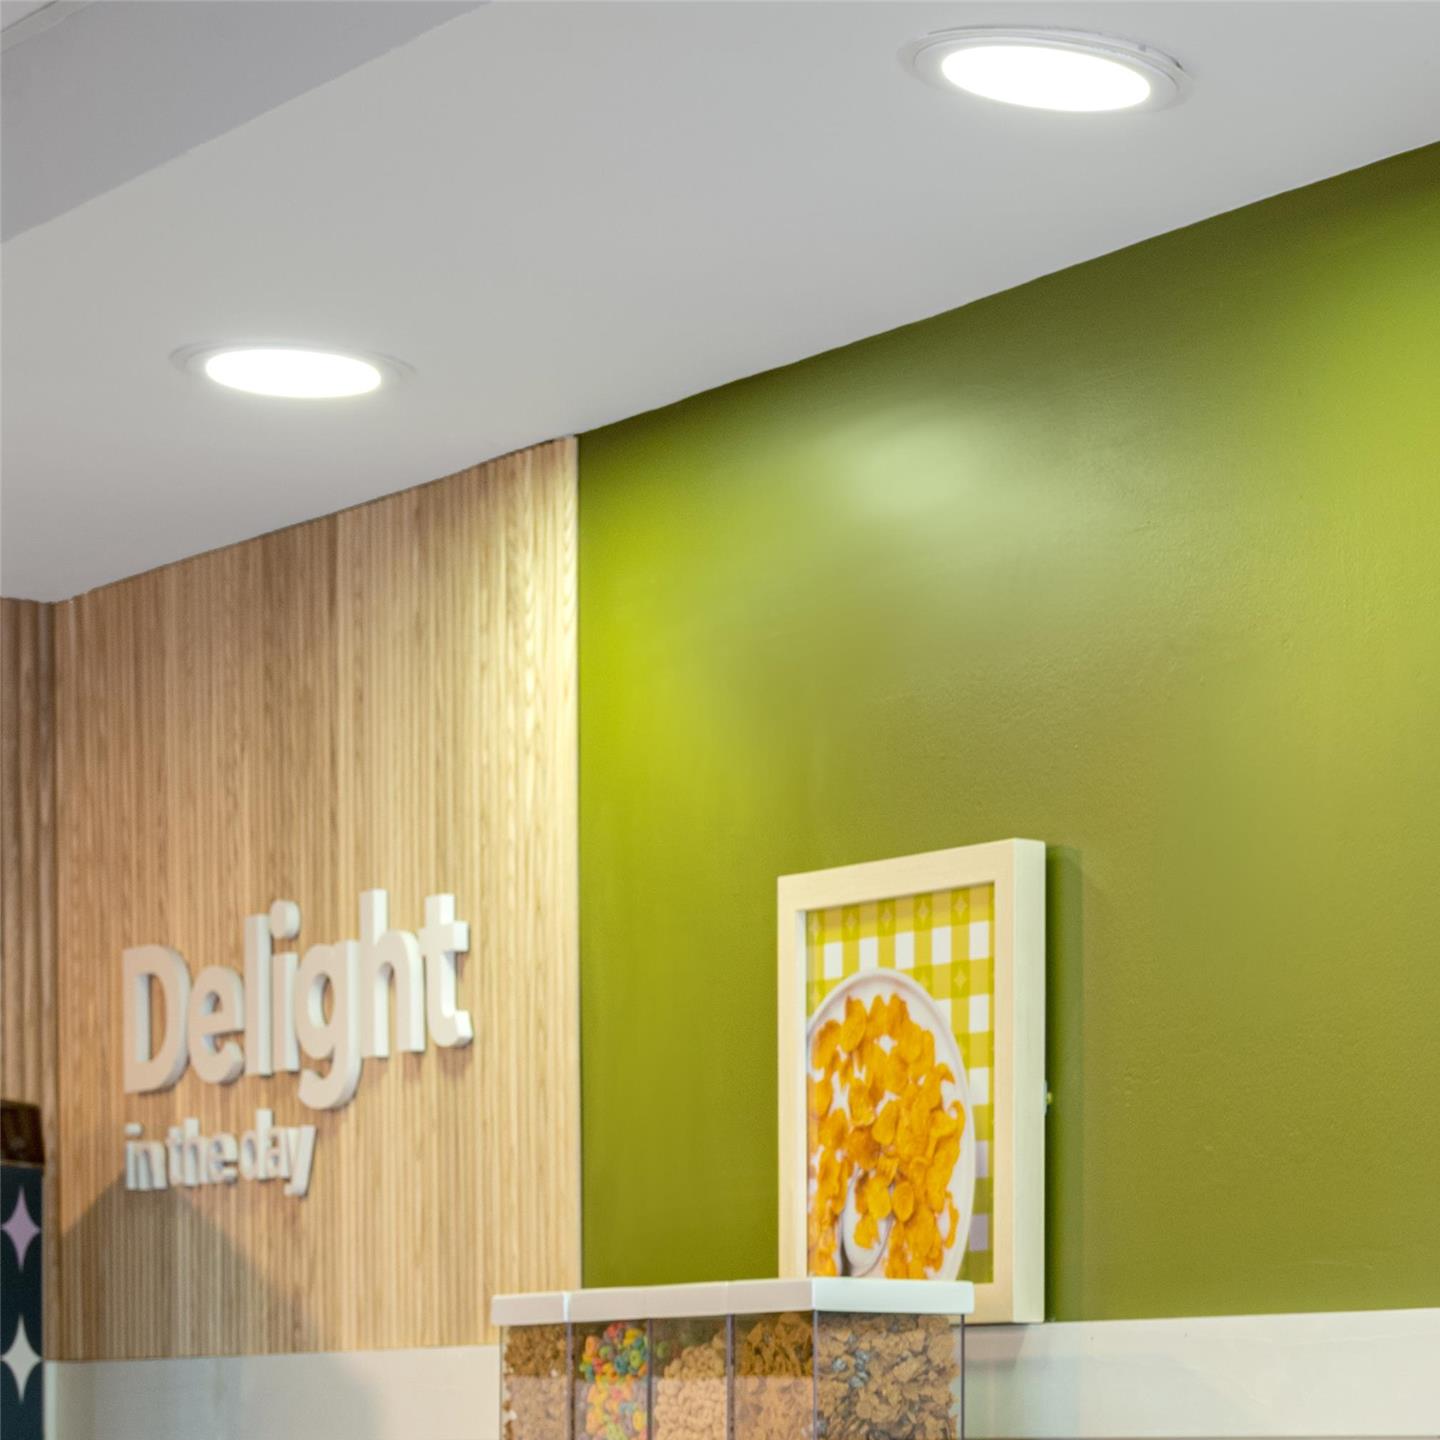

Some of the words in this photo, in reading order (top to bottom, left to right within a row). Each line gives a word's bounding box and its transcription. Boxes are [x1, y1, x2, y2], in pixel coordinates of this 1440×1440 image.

[123, 888, 473, 1110] Delight
[125, 1122, 168, 1190] in
[168, 1117, 238, 1186] the
[240, 1108, 316, 1197] day
